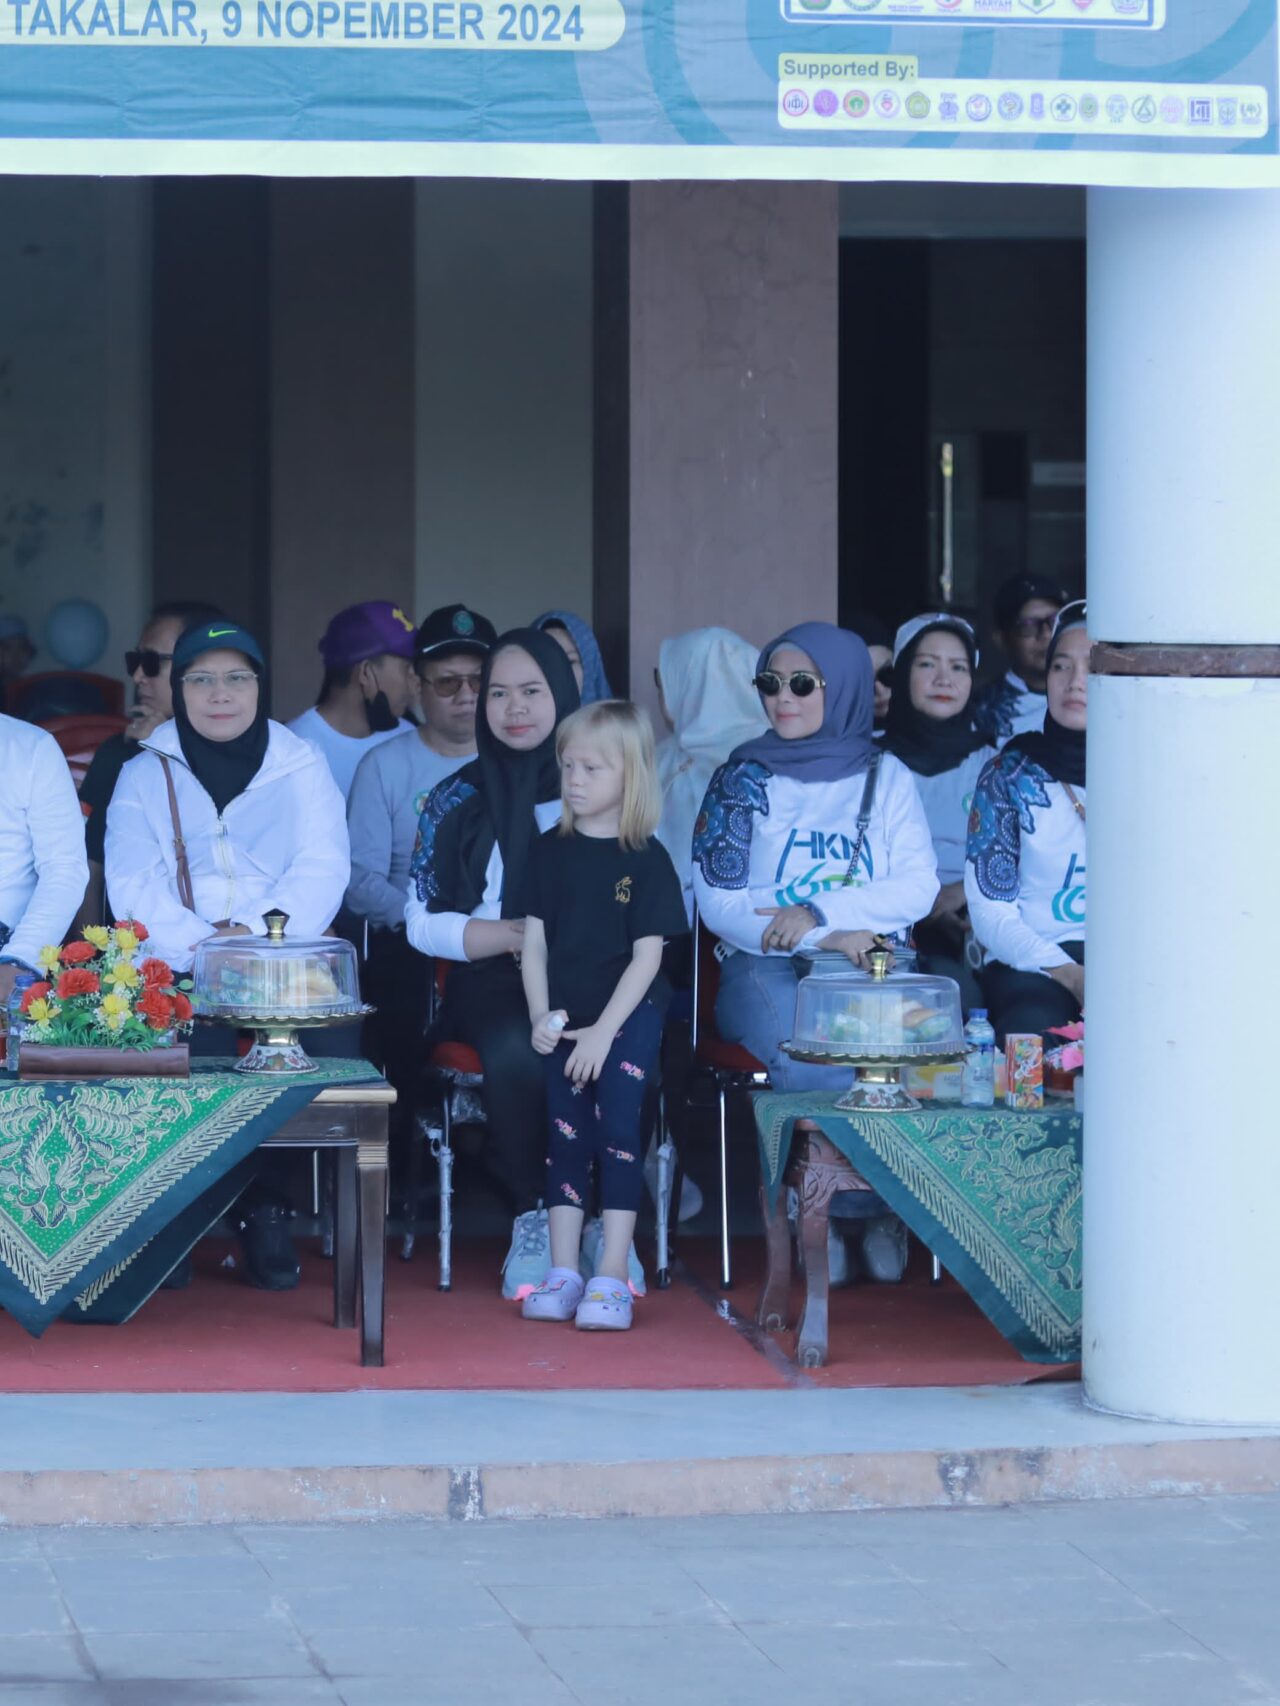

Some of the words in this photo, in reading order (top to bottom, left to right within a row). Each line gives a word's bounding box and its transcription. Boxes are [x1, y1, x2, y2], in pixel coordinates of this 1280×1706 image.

[7, 0, 208, 45] TAKALAR,
[222, 0, 242, 38] 9
[257, 0, 485, 41] NOPEMBER
[497, 3, 584, 42] 2024
[783, 58, 880, 79] Supported
[885, 60, 915, 81] By:
